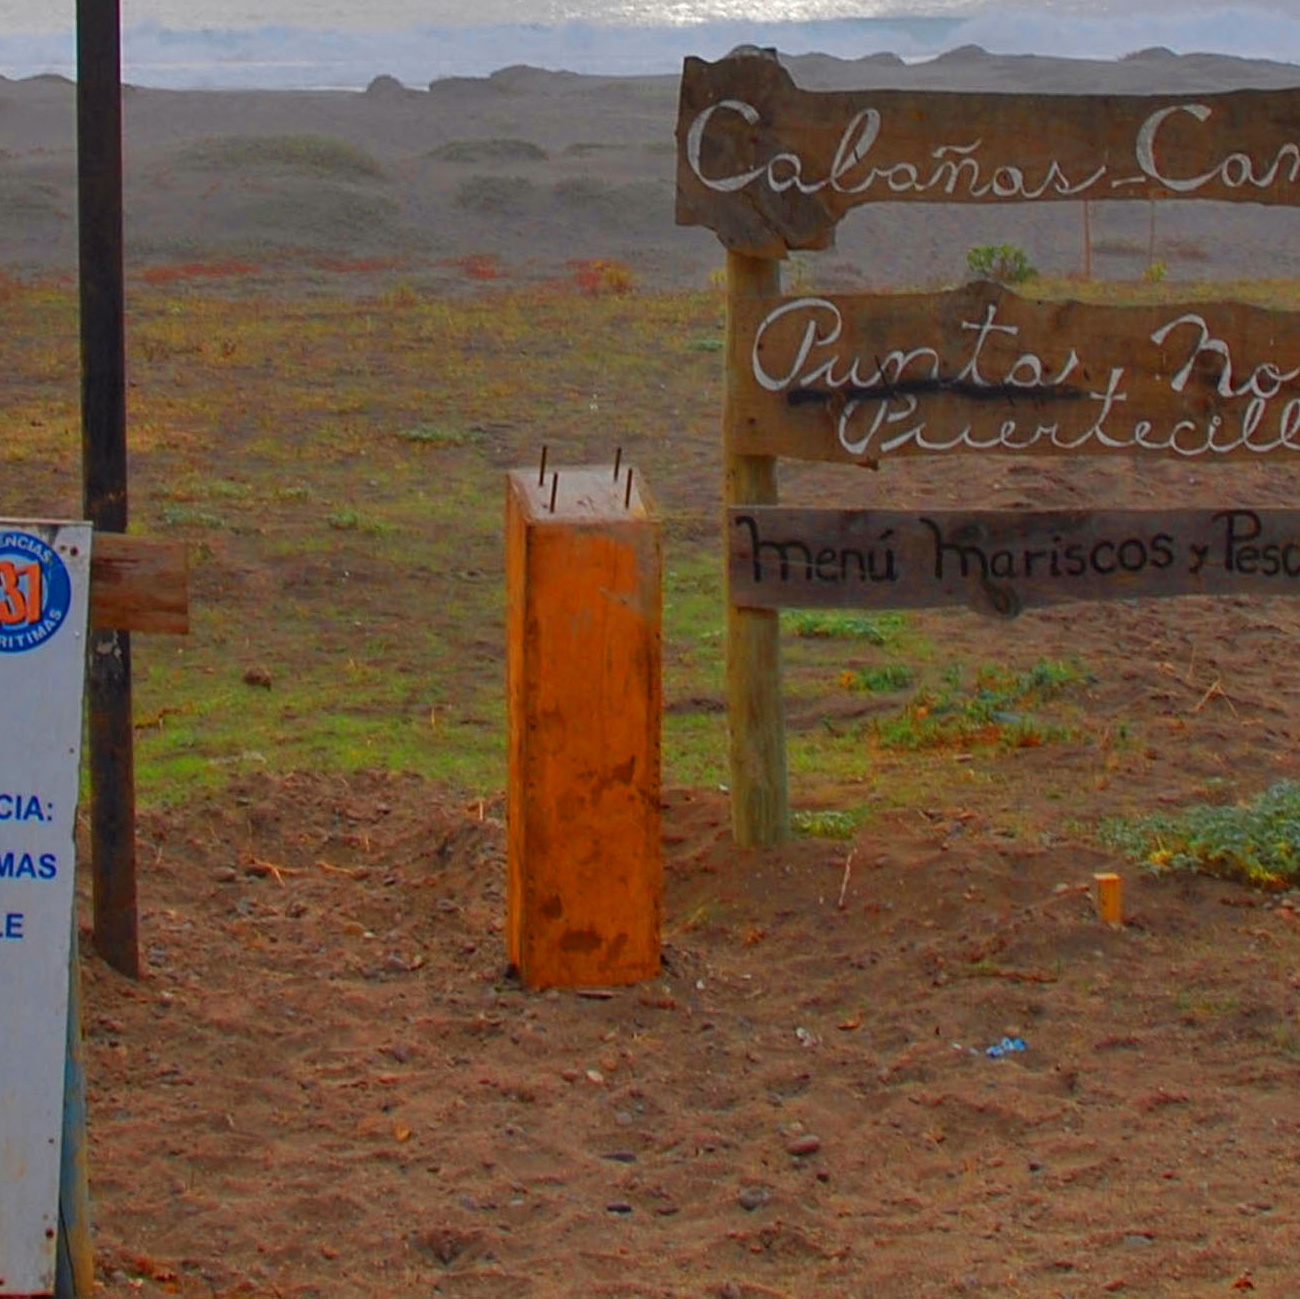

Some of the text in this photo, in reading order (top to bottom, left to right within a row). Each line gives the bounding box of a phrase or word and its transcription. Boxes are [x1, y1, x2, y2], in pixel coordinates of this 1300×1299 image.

[752, 297, 1079, 392] Punta
[735, 515, 899, 583] Menú
[918, 517, 1175, 581] Mariscos
